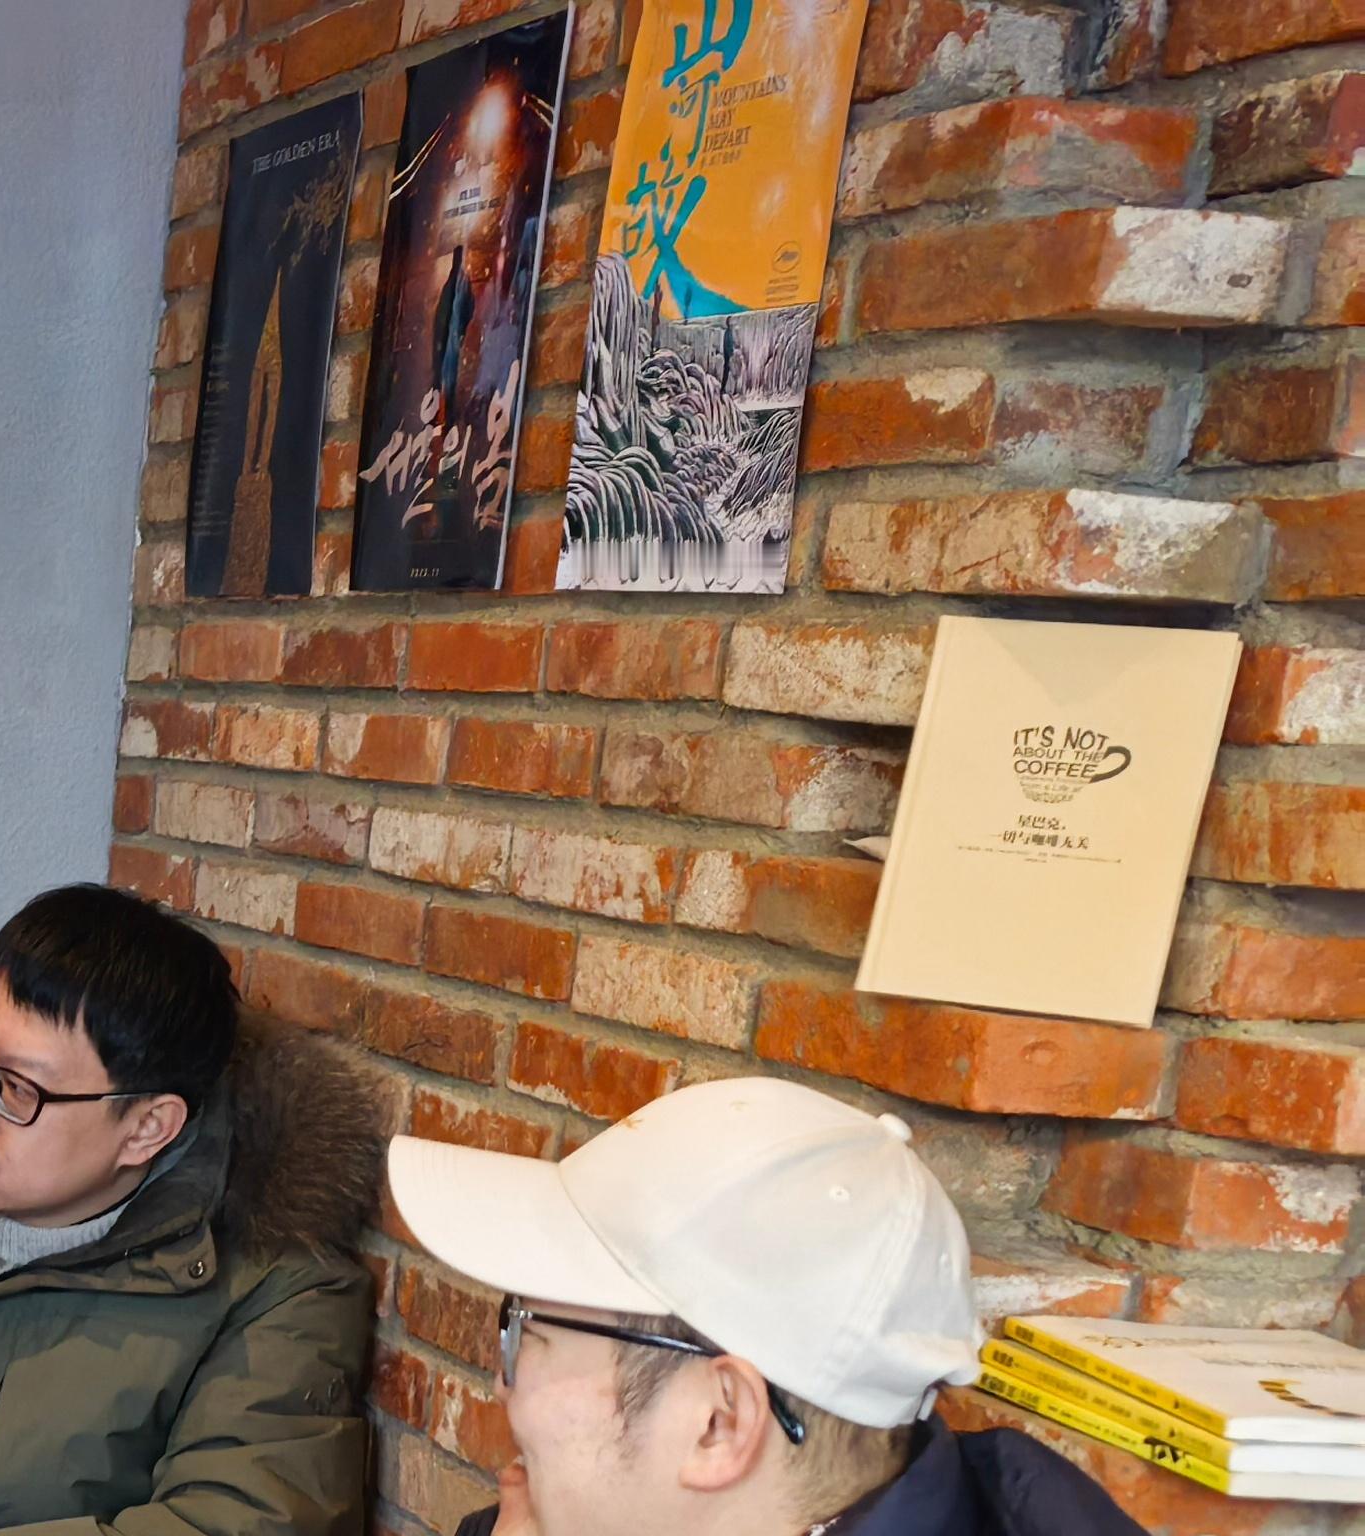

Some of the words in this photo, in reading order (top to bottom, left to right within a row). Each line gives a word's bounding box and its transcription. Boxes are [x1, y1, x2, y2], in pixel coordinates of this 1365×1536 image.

[1013, 725, 1055, 748] IT'S
[1063, 726, 1110, 751] NOT
[1012, 746, 1065, 760] ABOUT
[1075, 750, 1104, 763] THE
[1014, 759, 1098, 779] COFFEE
